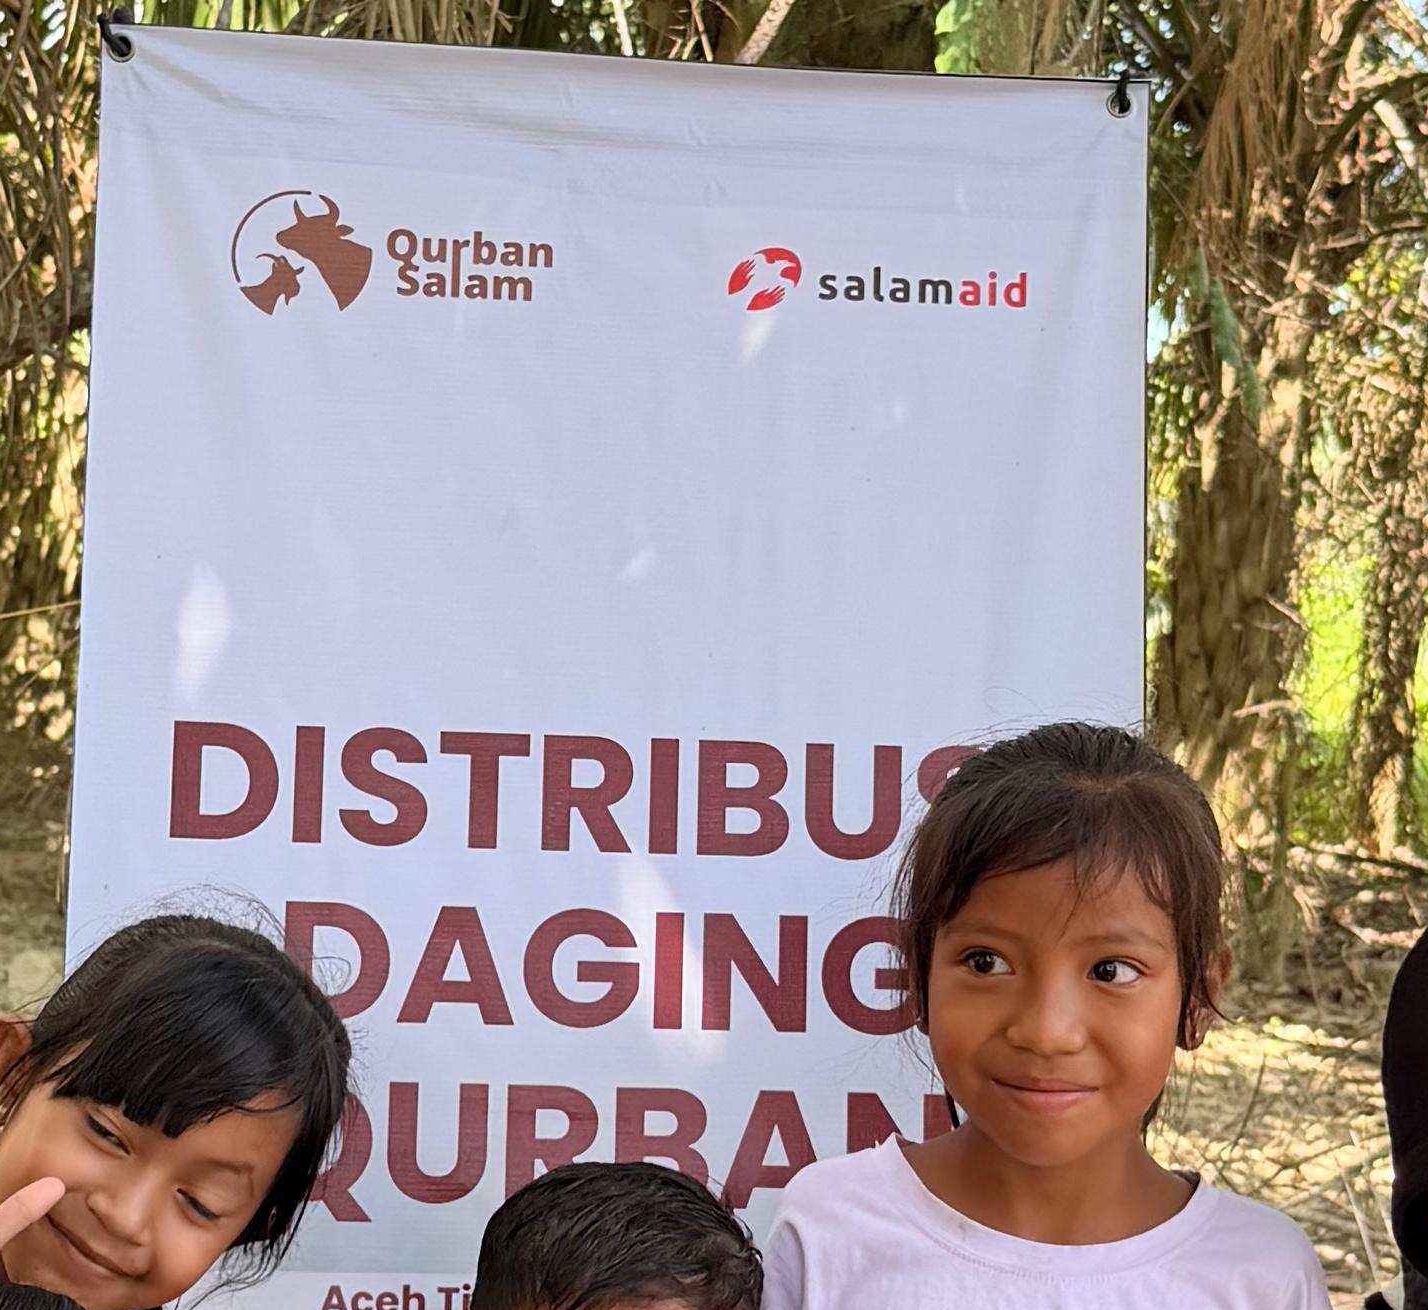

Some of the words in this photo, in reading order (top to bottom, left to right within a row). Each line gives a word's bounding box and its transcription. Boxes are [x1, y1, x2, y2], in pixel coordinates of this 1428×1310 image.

[386, 228, 554, 270] Qurban
[396, 264, 533, 302] Salam
[818, 266, 1028, 308] salamaid
[169, 720, 984, 860] DISTRIBU
[284, 900, 920, 1036] DAGING
